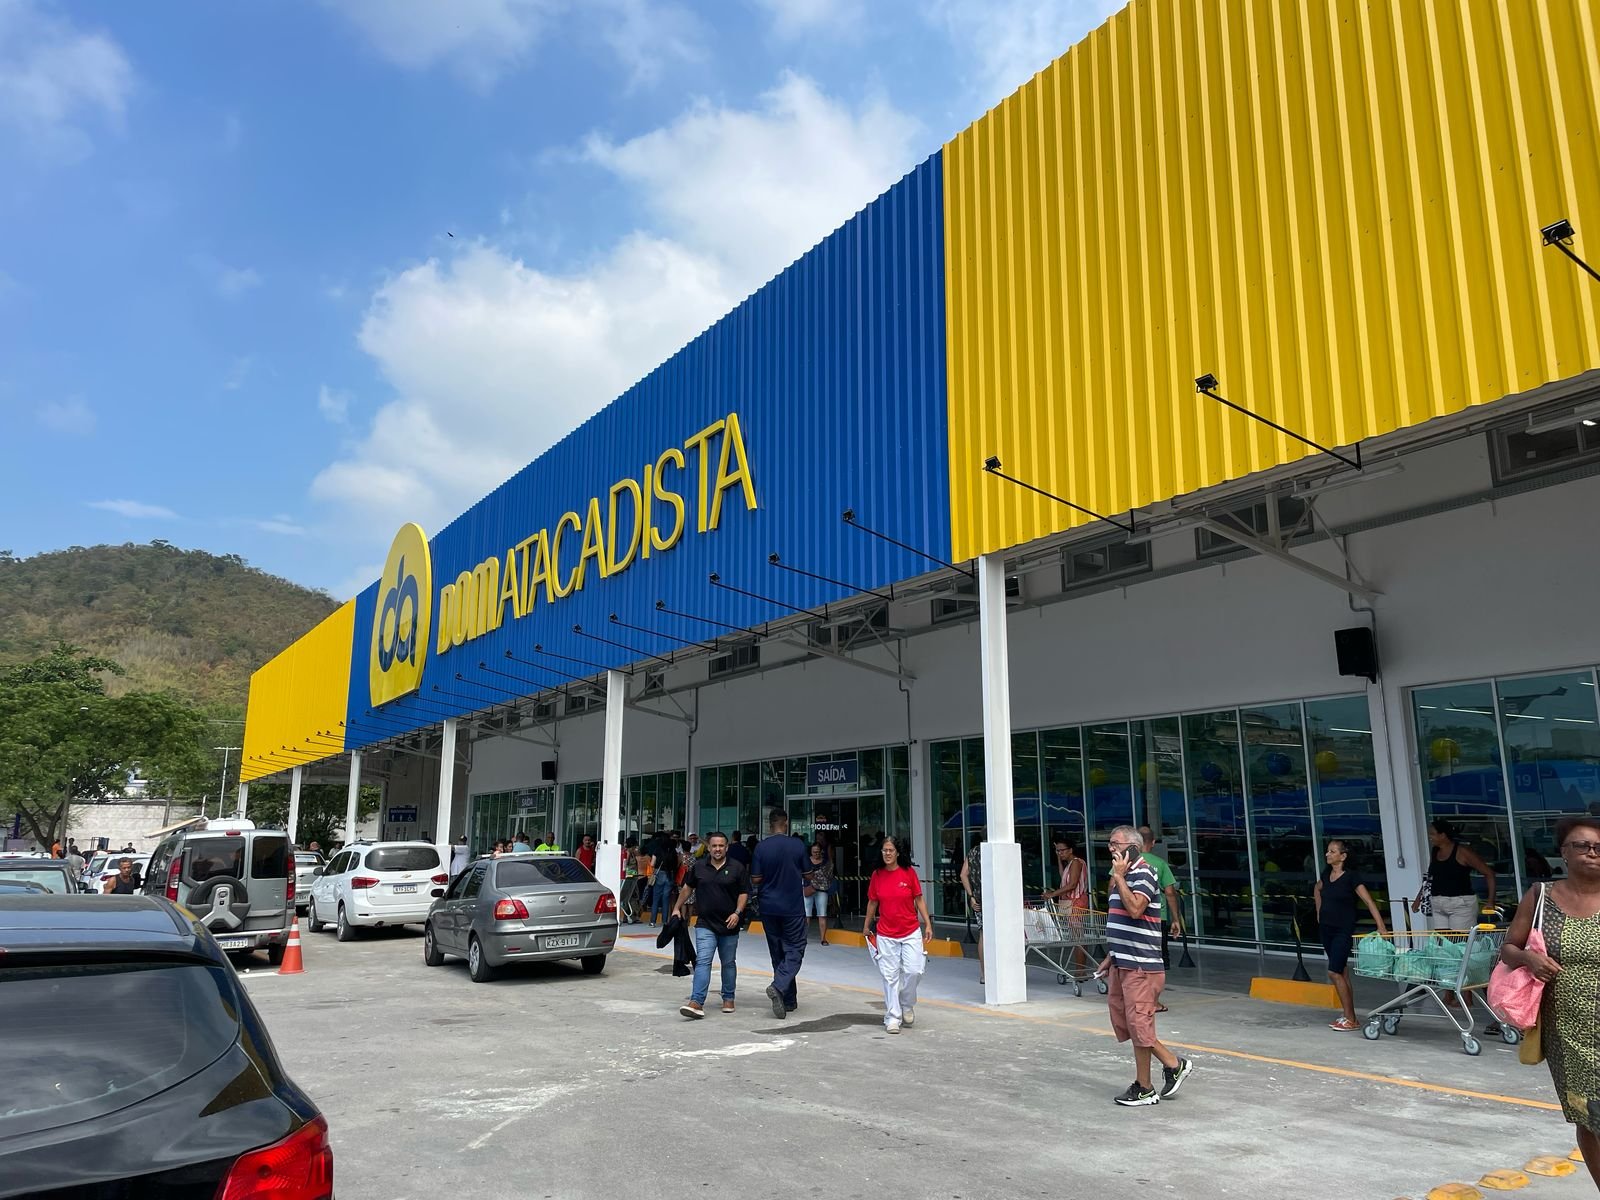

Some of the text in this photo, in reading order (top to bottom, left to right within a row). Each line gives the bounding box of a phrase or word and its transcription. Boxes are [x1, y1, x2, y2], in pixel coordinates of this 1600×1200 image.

[496, 413, 757, 628] ATACADISTA
[817, 765, 846, 782] SAÍDA
[1515, 774, 1532, 787] 19
